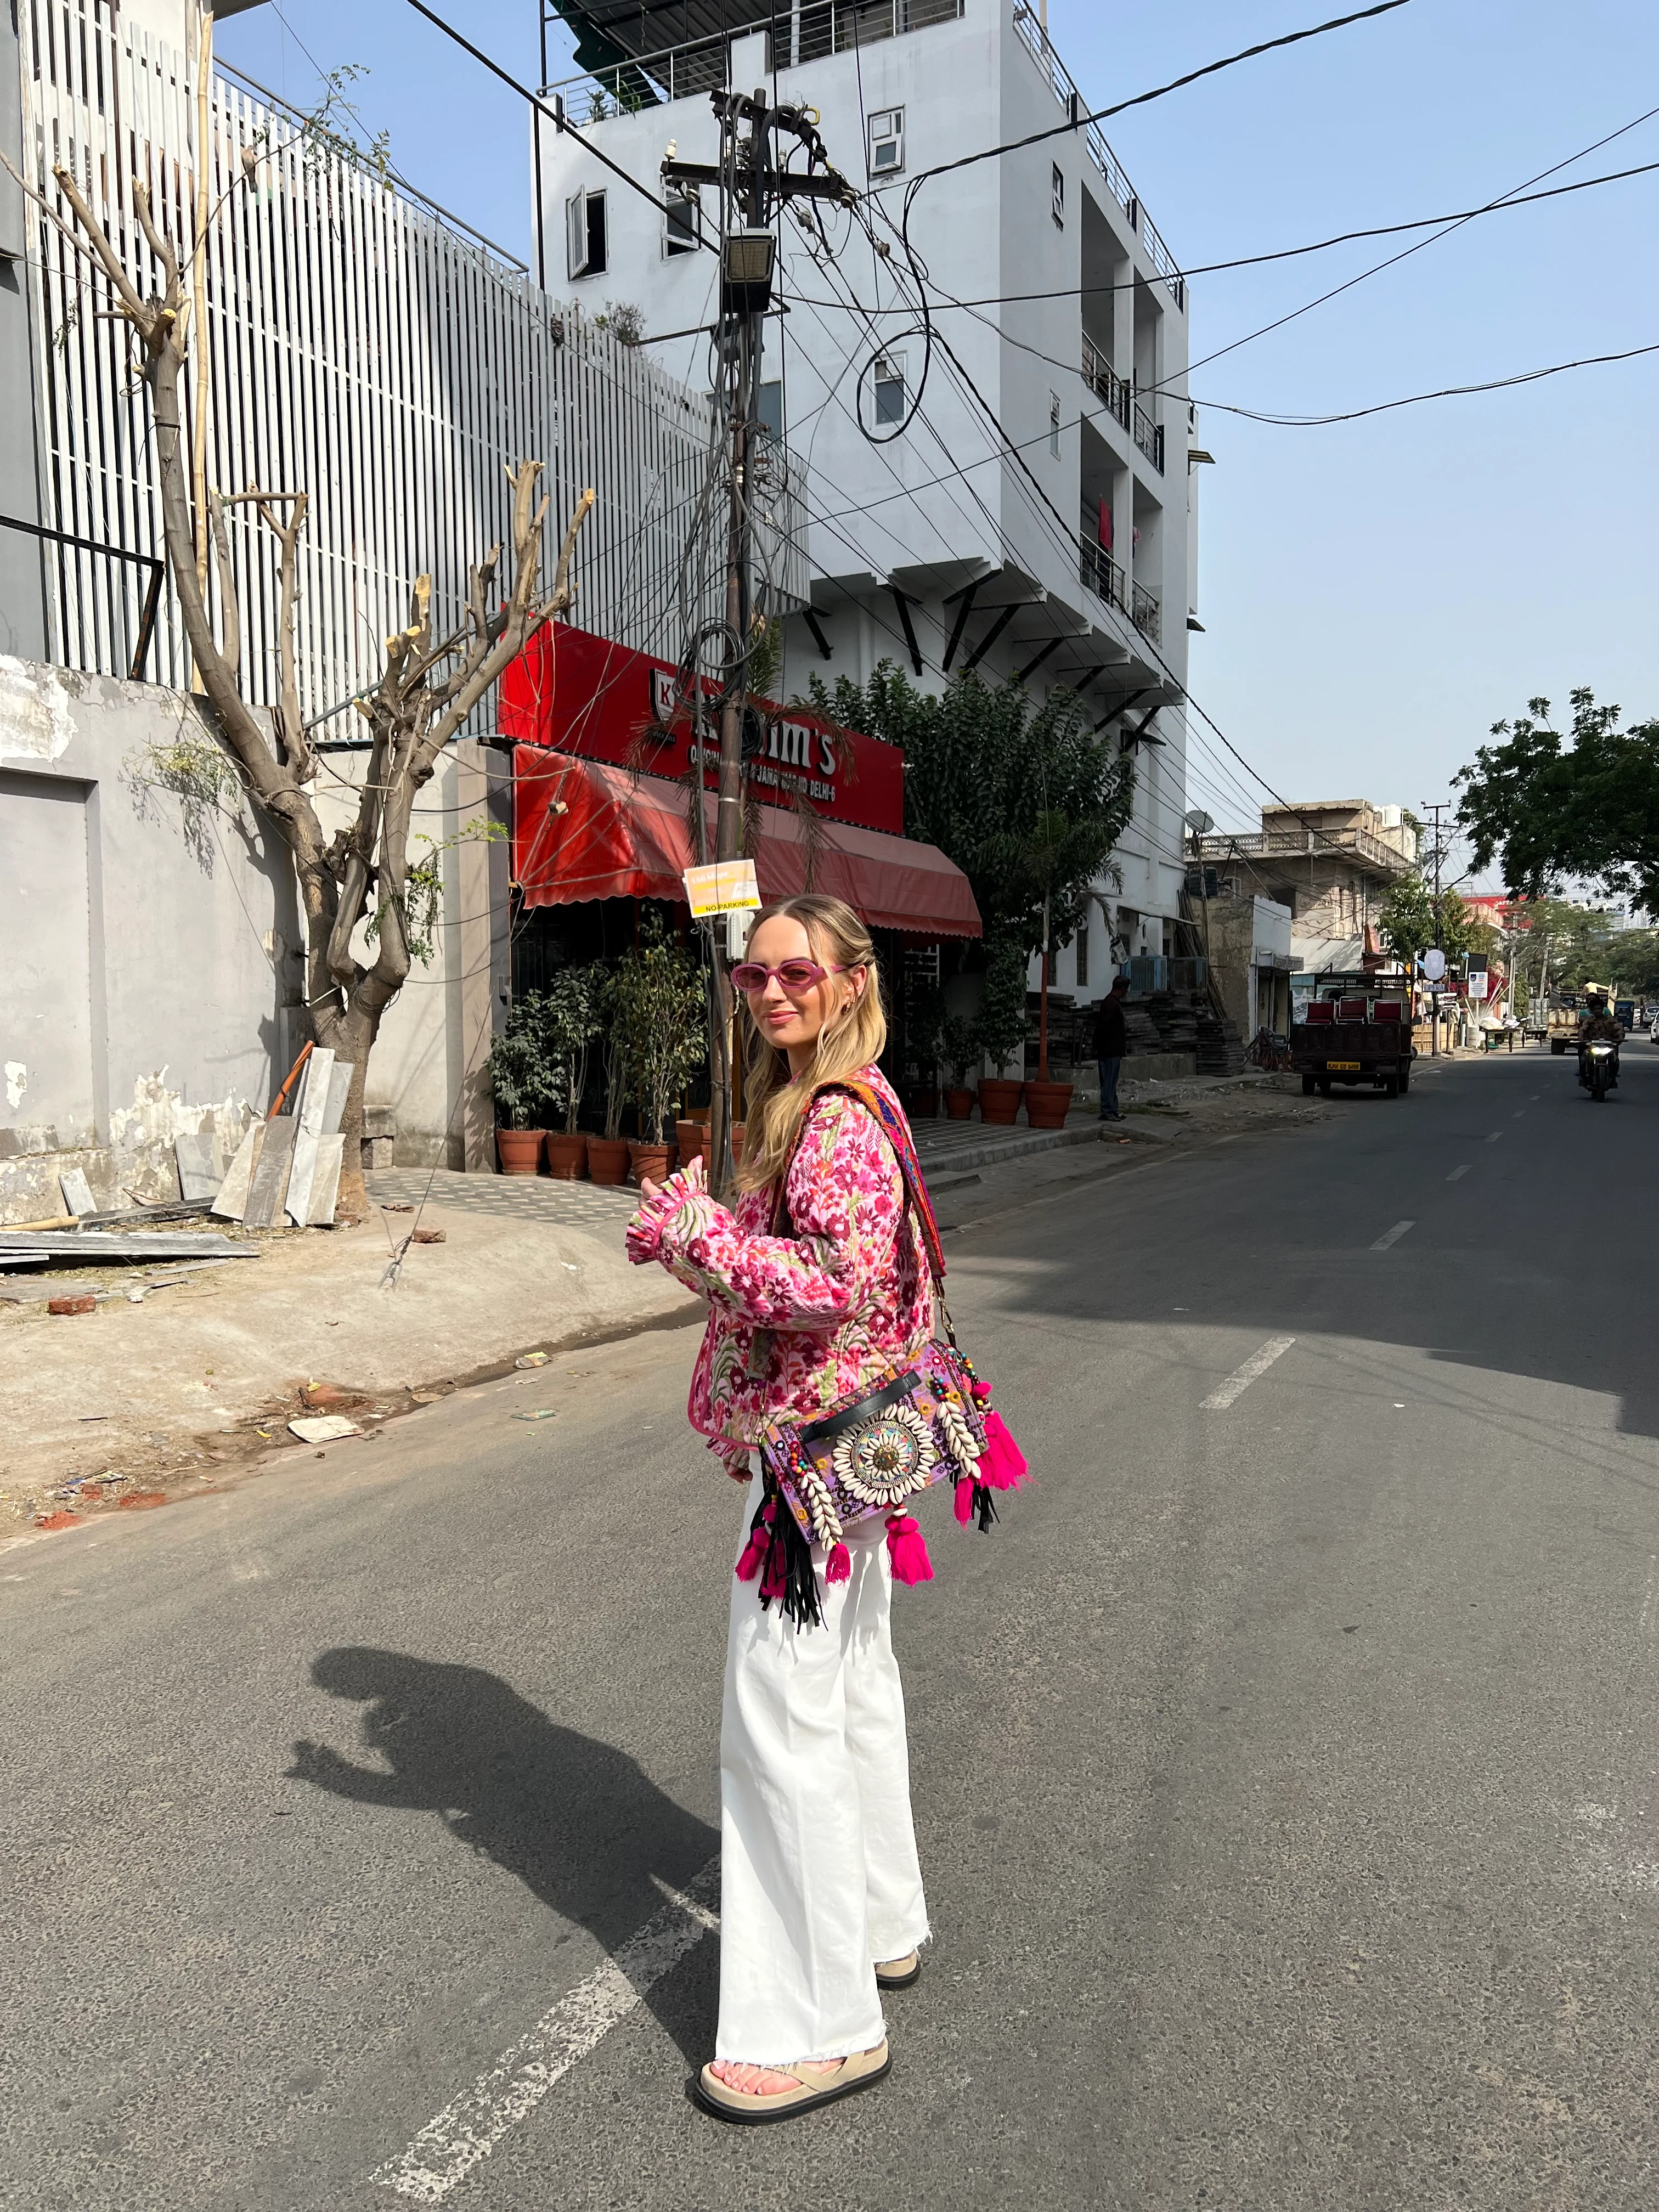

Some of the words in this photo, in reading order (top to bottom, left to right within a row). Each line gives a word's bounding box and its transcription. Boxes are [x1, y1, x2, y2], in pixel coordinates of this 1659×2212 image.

[661, 681, 671, 706] K
[757, 765, 778, 787] JAMA
[810, 780, 835, 802] DELHI-6
[737, 884, 752, 893] ACT
[719, 901, 749, 910] PARKING
